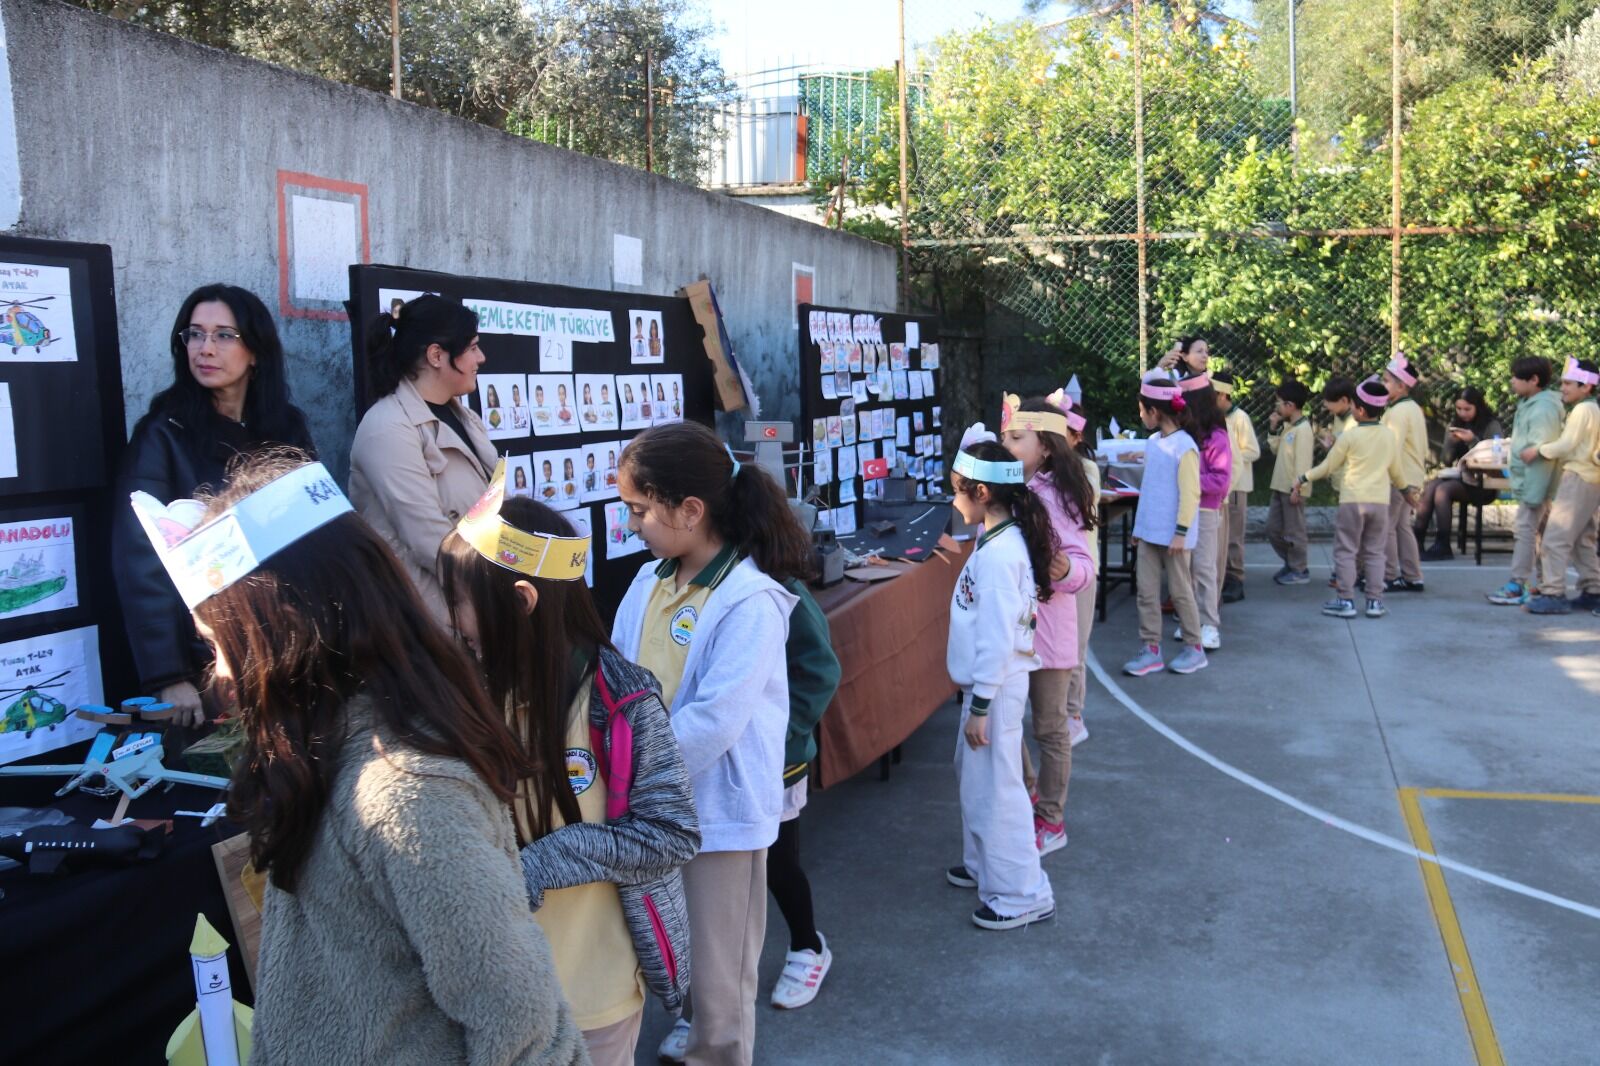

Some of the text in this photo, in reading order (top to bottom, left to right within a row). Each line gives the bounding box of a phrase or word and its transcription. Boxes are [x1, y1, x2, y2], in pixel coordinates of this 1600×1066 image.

[471, 304, 610, 337] EMLEKETİM TÜRKİYE
[0, 523, 70, 544] ANADOLU
[16, 665, 42, 677] ATAK
